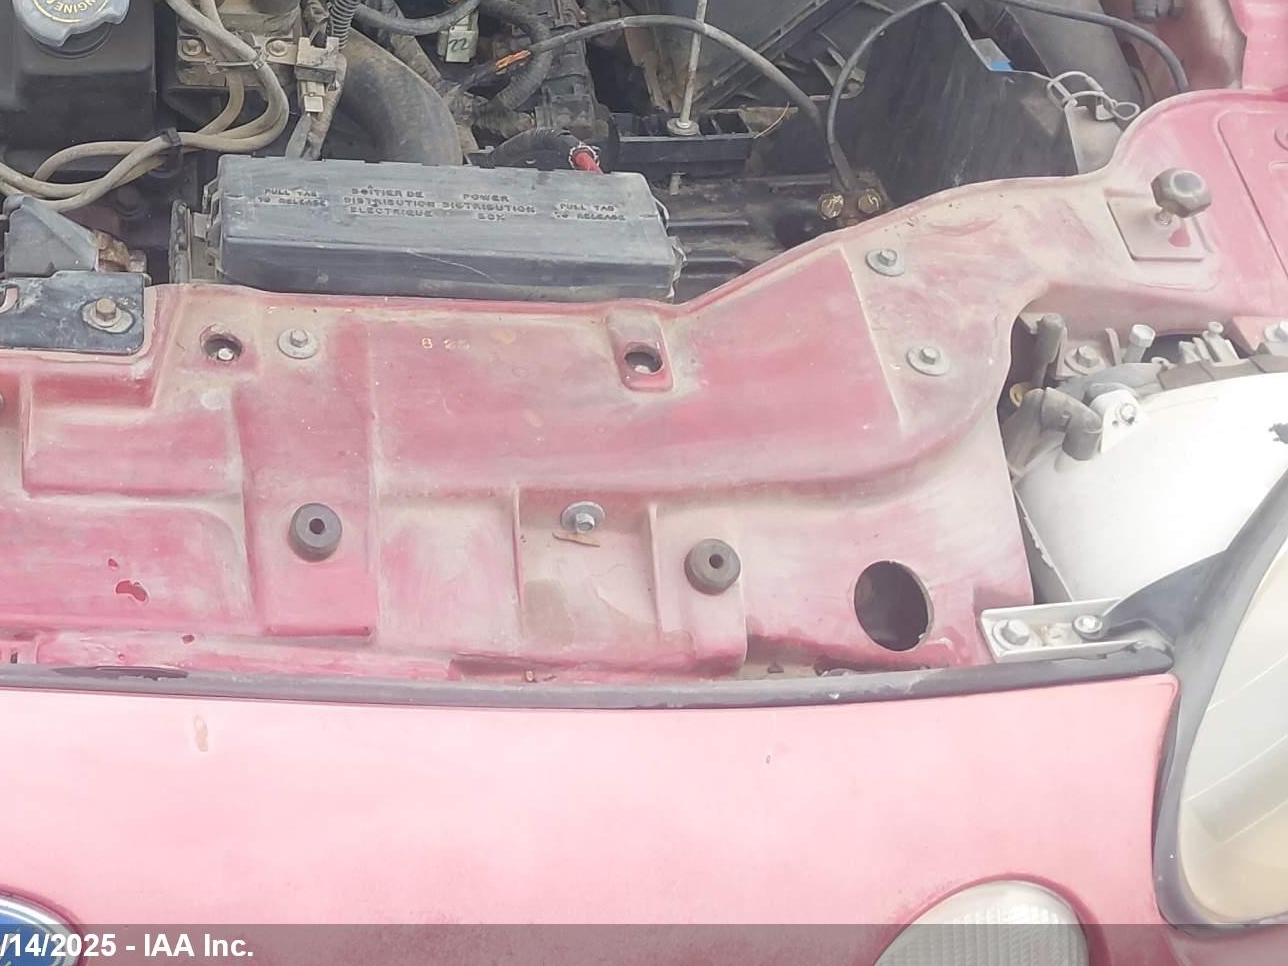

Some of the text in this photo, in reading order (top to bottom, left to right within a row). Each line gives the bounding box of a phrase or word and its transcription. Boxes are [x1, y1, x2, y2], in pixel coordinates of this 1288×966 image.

[264, 188, 290, 196] PULL
[343, 196, 435, 208] DISTRIBUTION
[463, 193, 509, 202] POWER
[442, 201, 536, 213] DISTRIBUTION
[560, 202, 615, 212] PULL TAB
